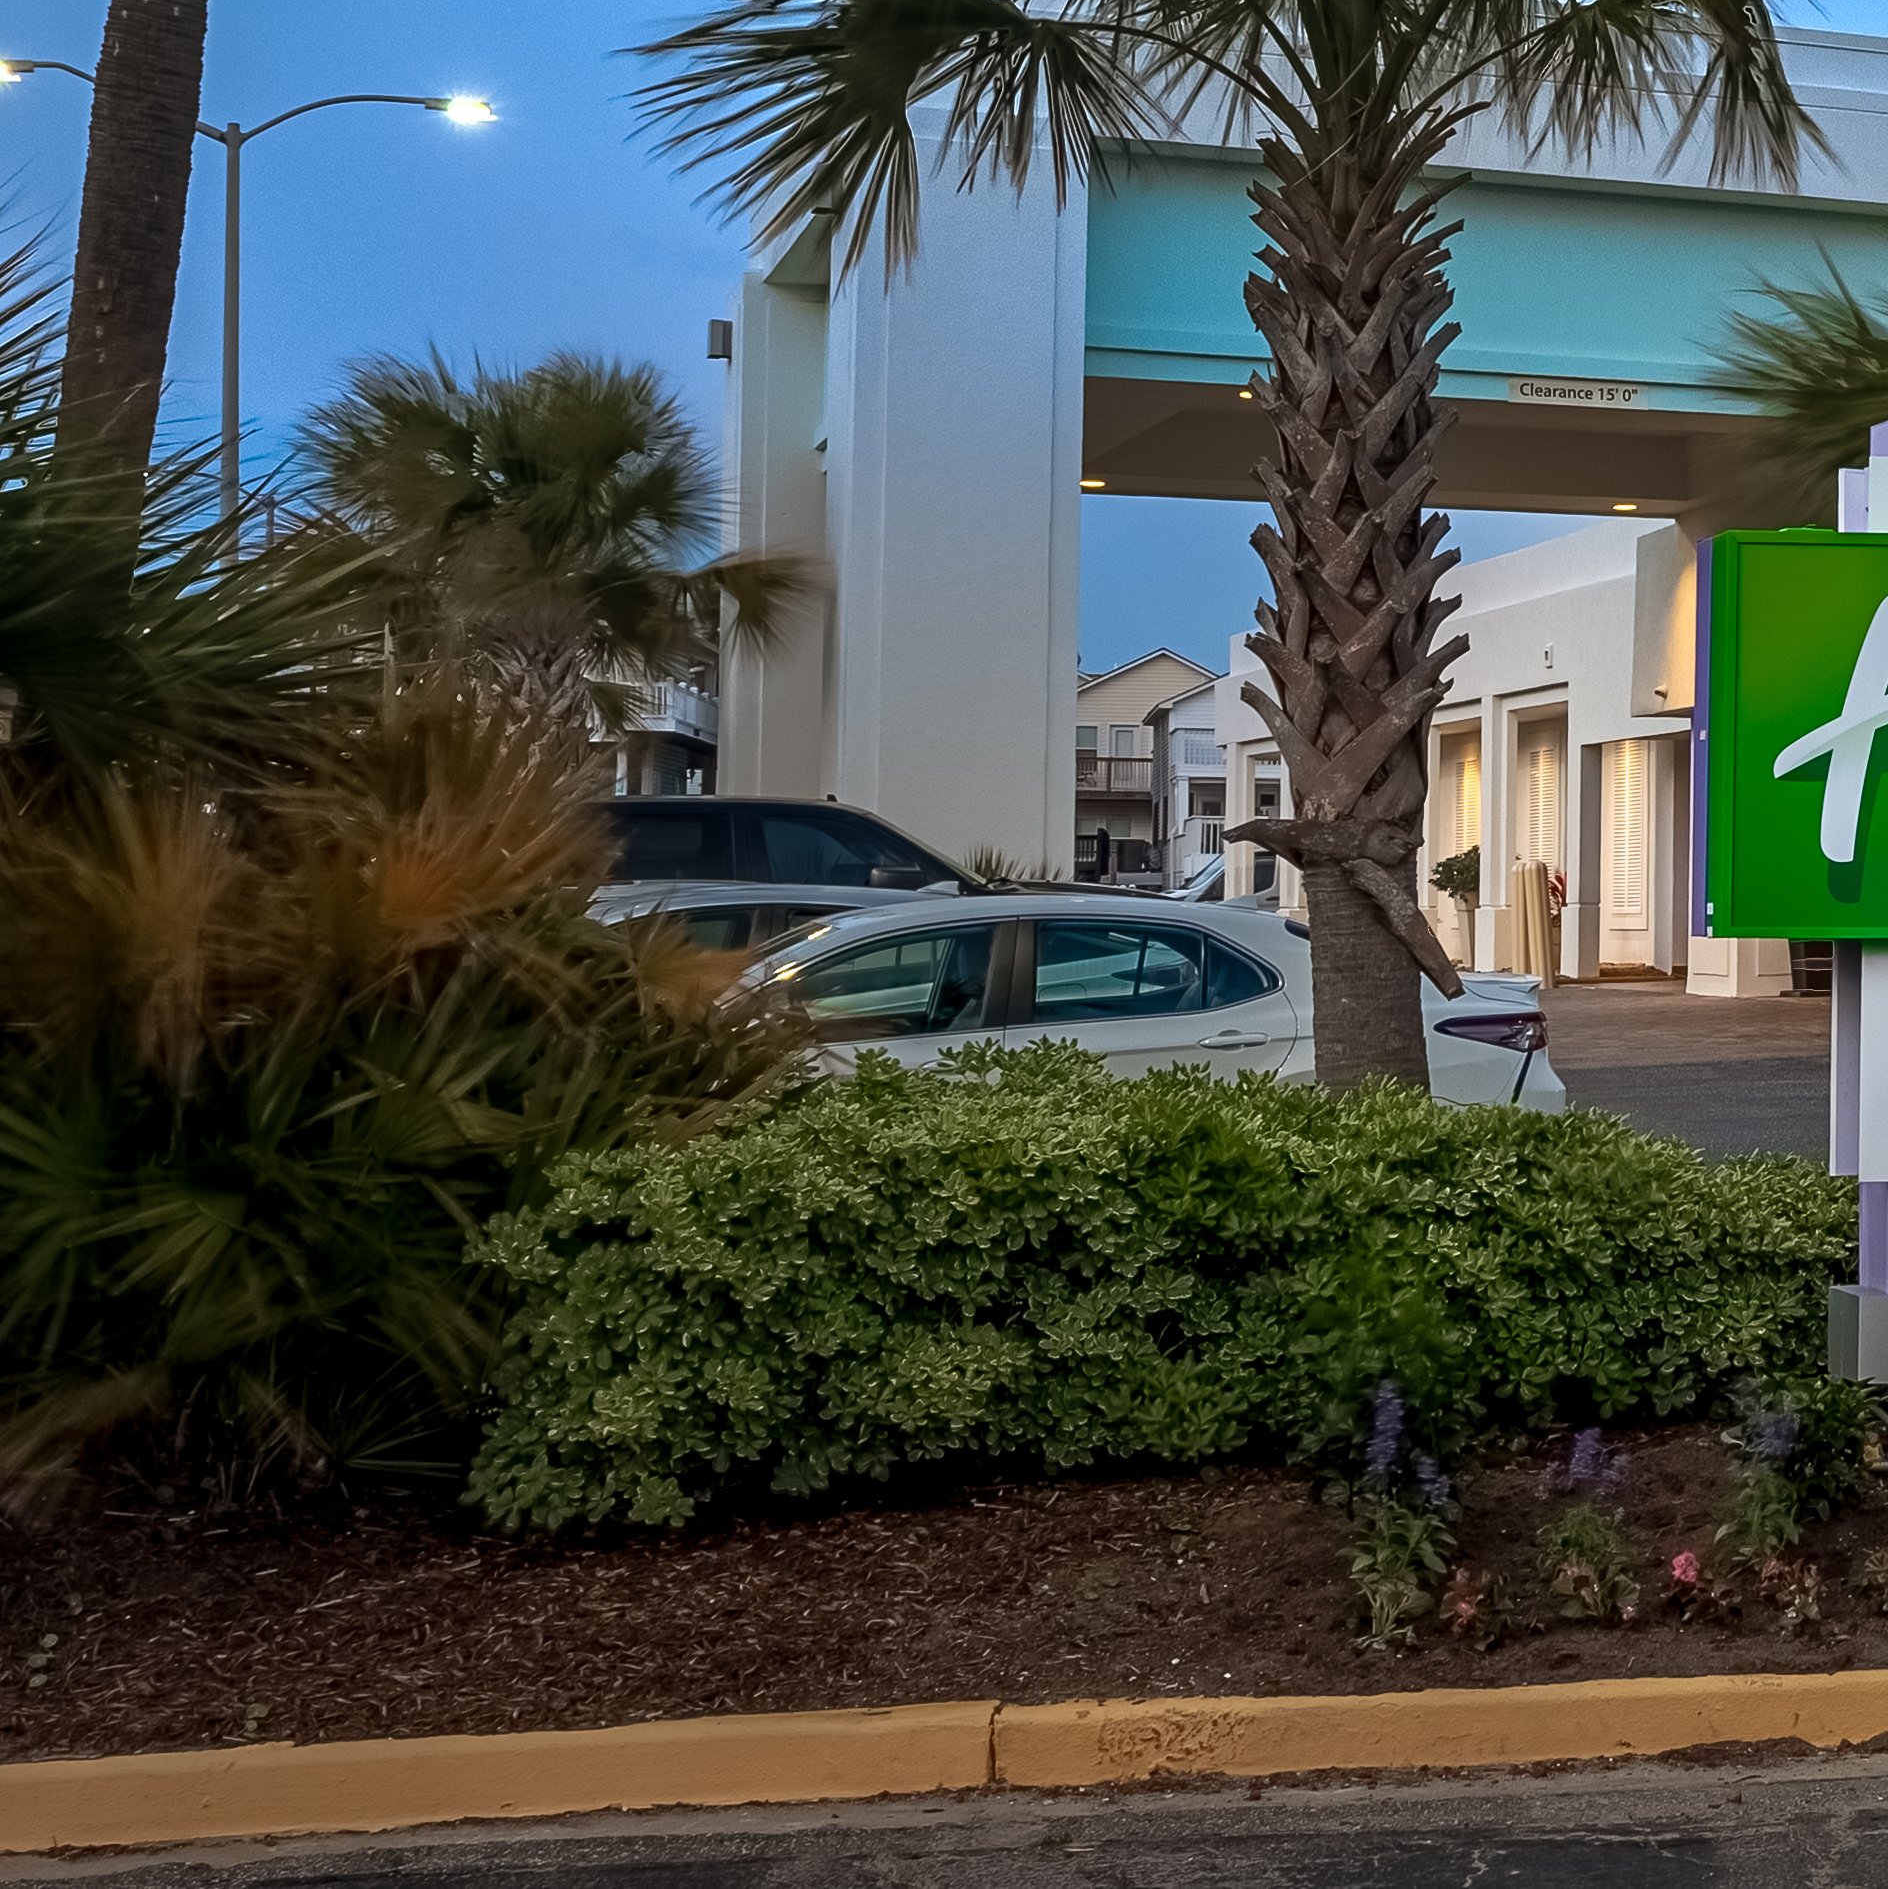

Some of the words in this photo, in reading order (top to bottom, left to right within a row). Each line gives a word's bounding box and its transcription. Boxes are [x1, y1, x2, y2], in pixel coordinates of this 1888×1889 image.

[1519, 382, 1593, 401] Clearance
[1598, 387, 1619, 402] 15'
[1622, 388, 1638, 403] 0"
